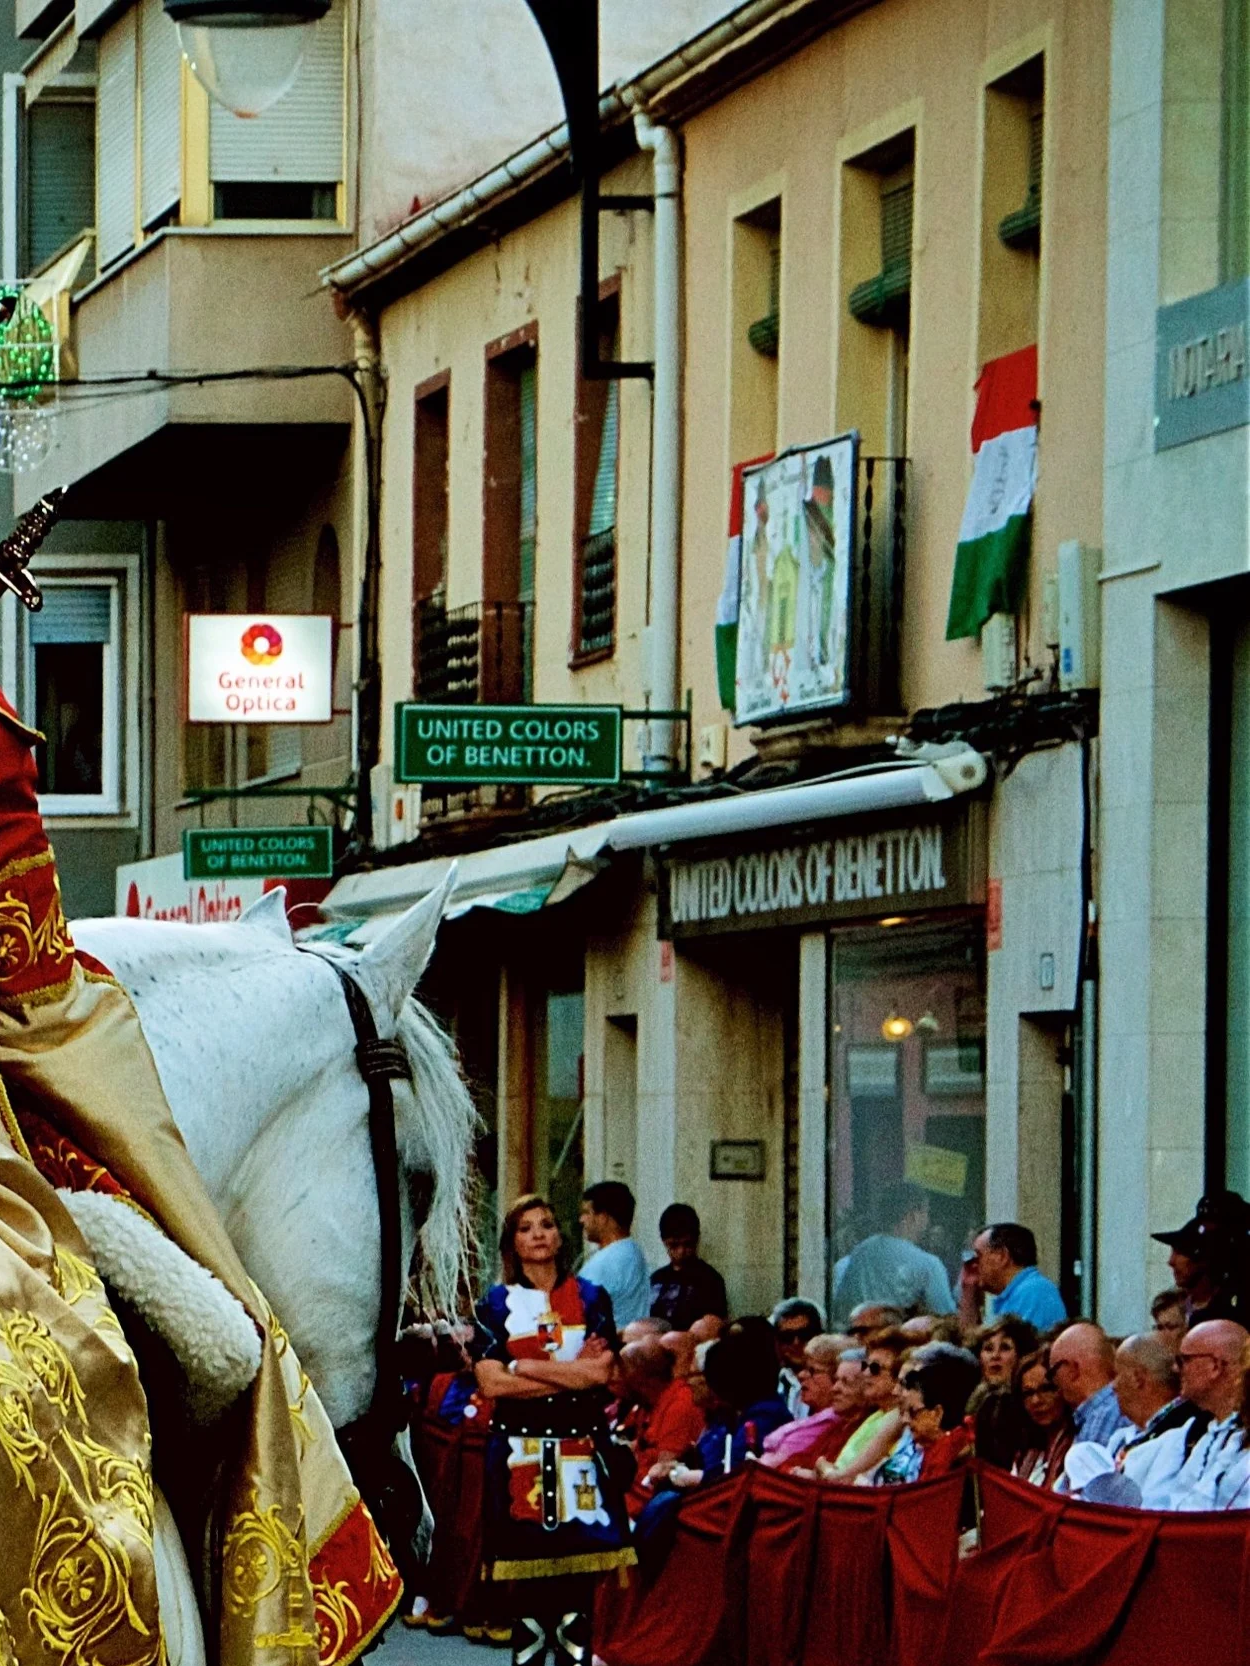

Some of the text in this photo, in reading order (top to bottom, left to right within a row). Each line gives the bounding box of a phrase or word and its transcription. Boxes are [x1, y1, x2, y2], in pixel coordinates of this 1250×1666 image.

[218, 671, 305, 689] General
[225, 693, 296, 715] Optica
[417, 718, 599, 741] UNITED COLORS
[426, 744, 592, 767] OF BENETTON.
[201, 836, 316, 852] UNITED COLORS
[207, 855, 226, 869] OF
[670, 823, 947, 923] UNITED COLORS OF BENETTON.
